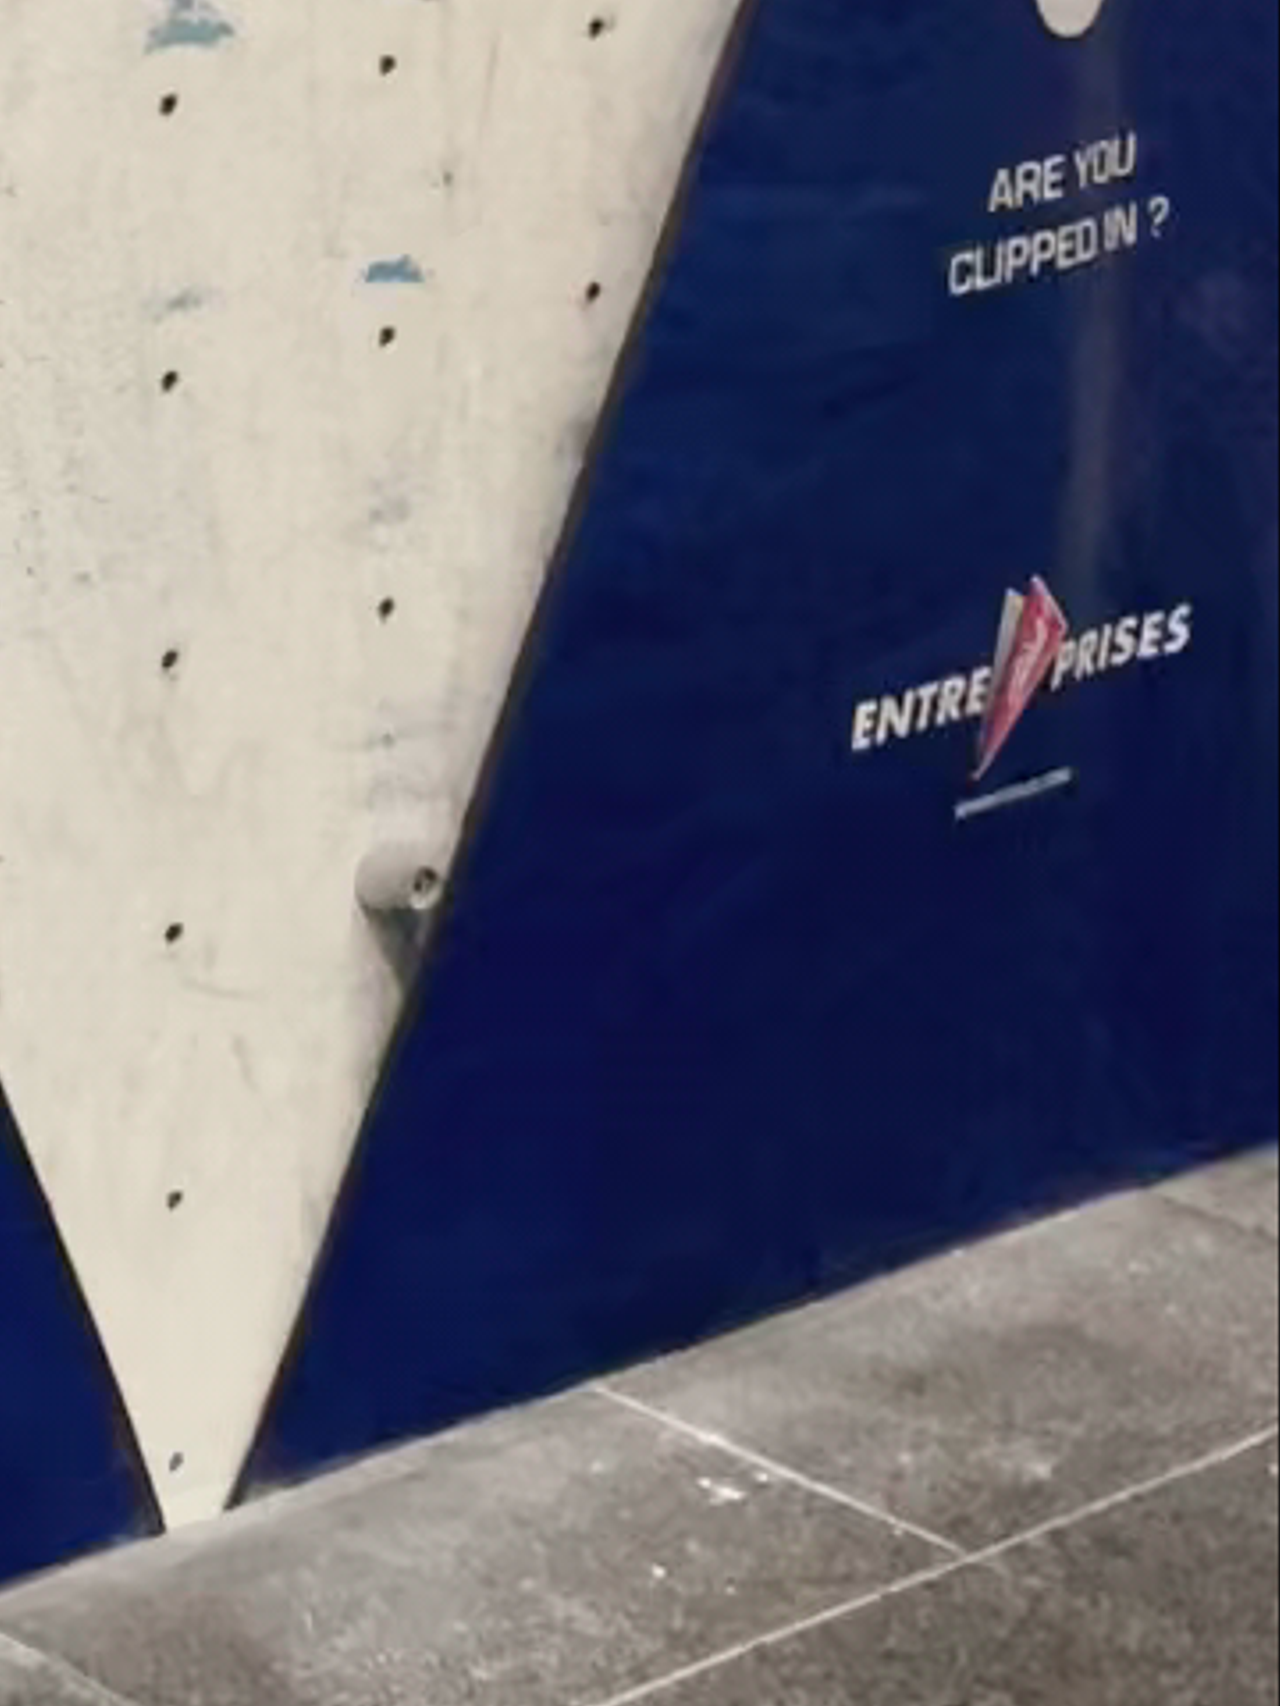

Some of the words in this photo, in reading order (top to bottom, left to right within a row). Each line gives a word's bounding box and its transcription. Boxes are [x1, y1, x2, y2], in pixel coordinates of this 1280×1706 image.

[988, 153, 1067, 213] ARE
[1073, 131, 1138, 190] YOU
[948, 217, 1099, 297] CLIPPED
[1102, 202, 1138, 253] IN
[1147, 196, 1170, 238] ?
[850, 664, 993, 753] ENTRE
[1051, 603, 1193, 693] PRISES
